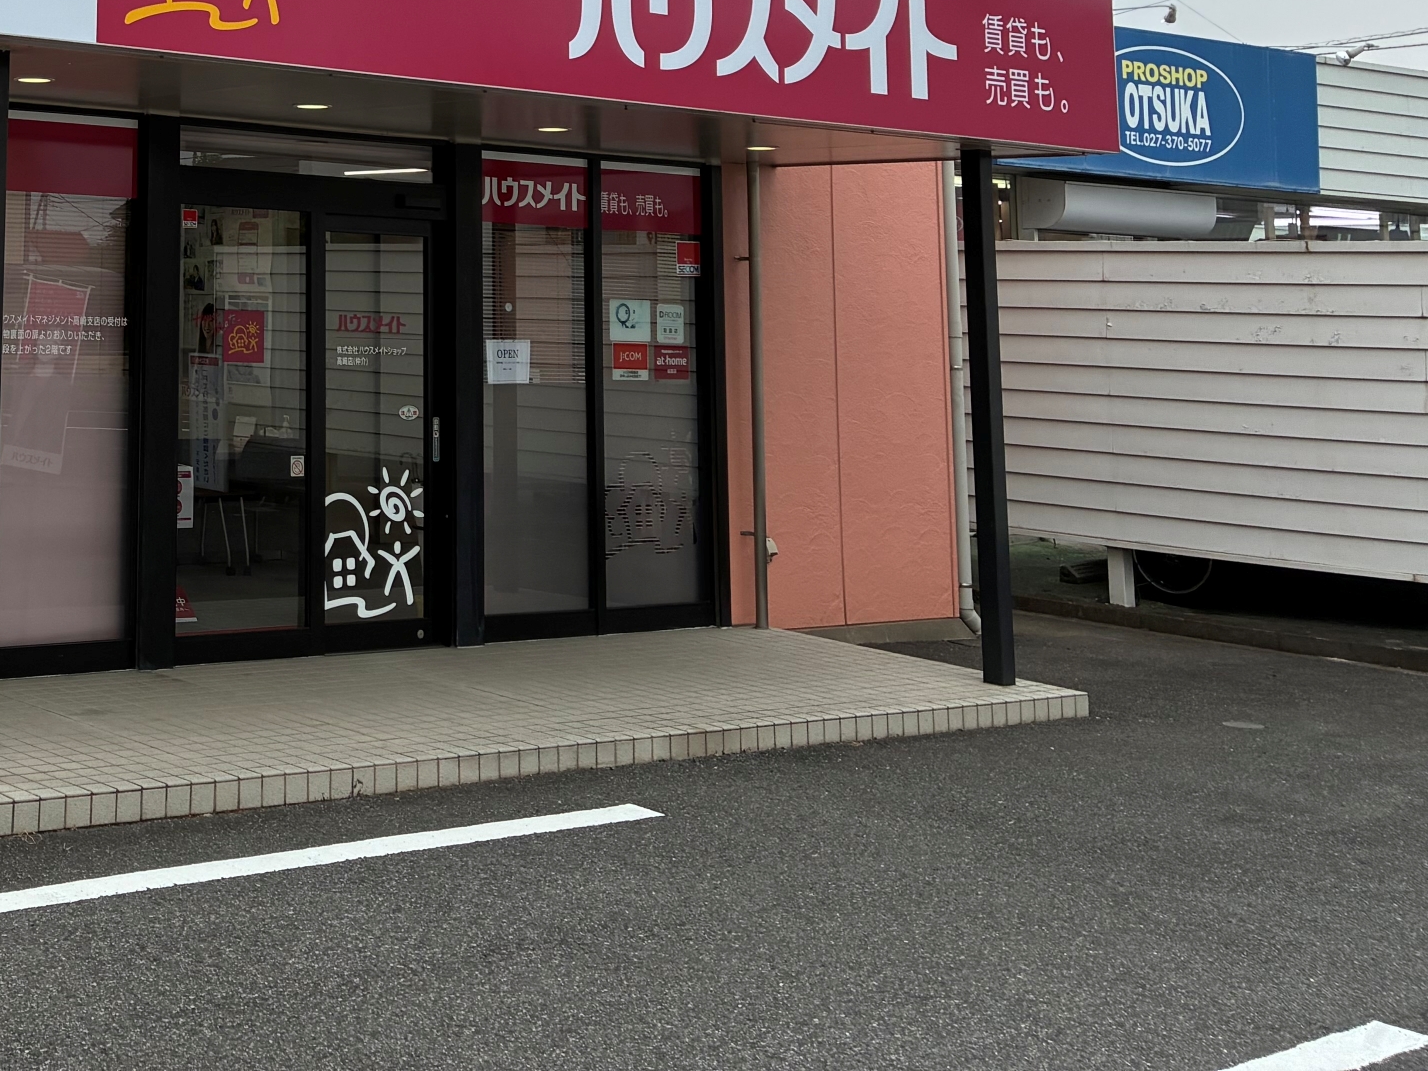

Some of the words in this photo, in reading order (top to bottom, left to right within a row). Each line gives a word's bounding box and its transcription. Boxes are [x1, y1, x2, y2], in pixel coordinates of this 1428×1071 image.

[981, 13, 1065, 63] 賃貸も、
[984, 65, 1069, 114] 売買も。
[1121, 59, 1208, 89] PROSHOP
[1123, 82, 1211, 136] OTSUKA
[1124, 130, 1212, 153] TEL.027-370-5077
[481, 176, 587, 212] ハウスメイト
[335, 314, 407, 334] ハウスメイト
[496, 349, 519, 359] OPEN
